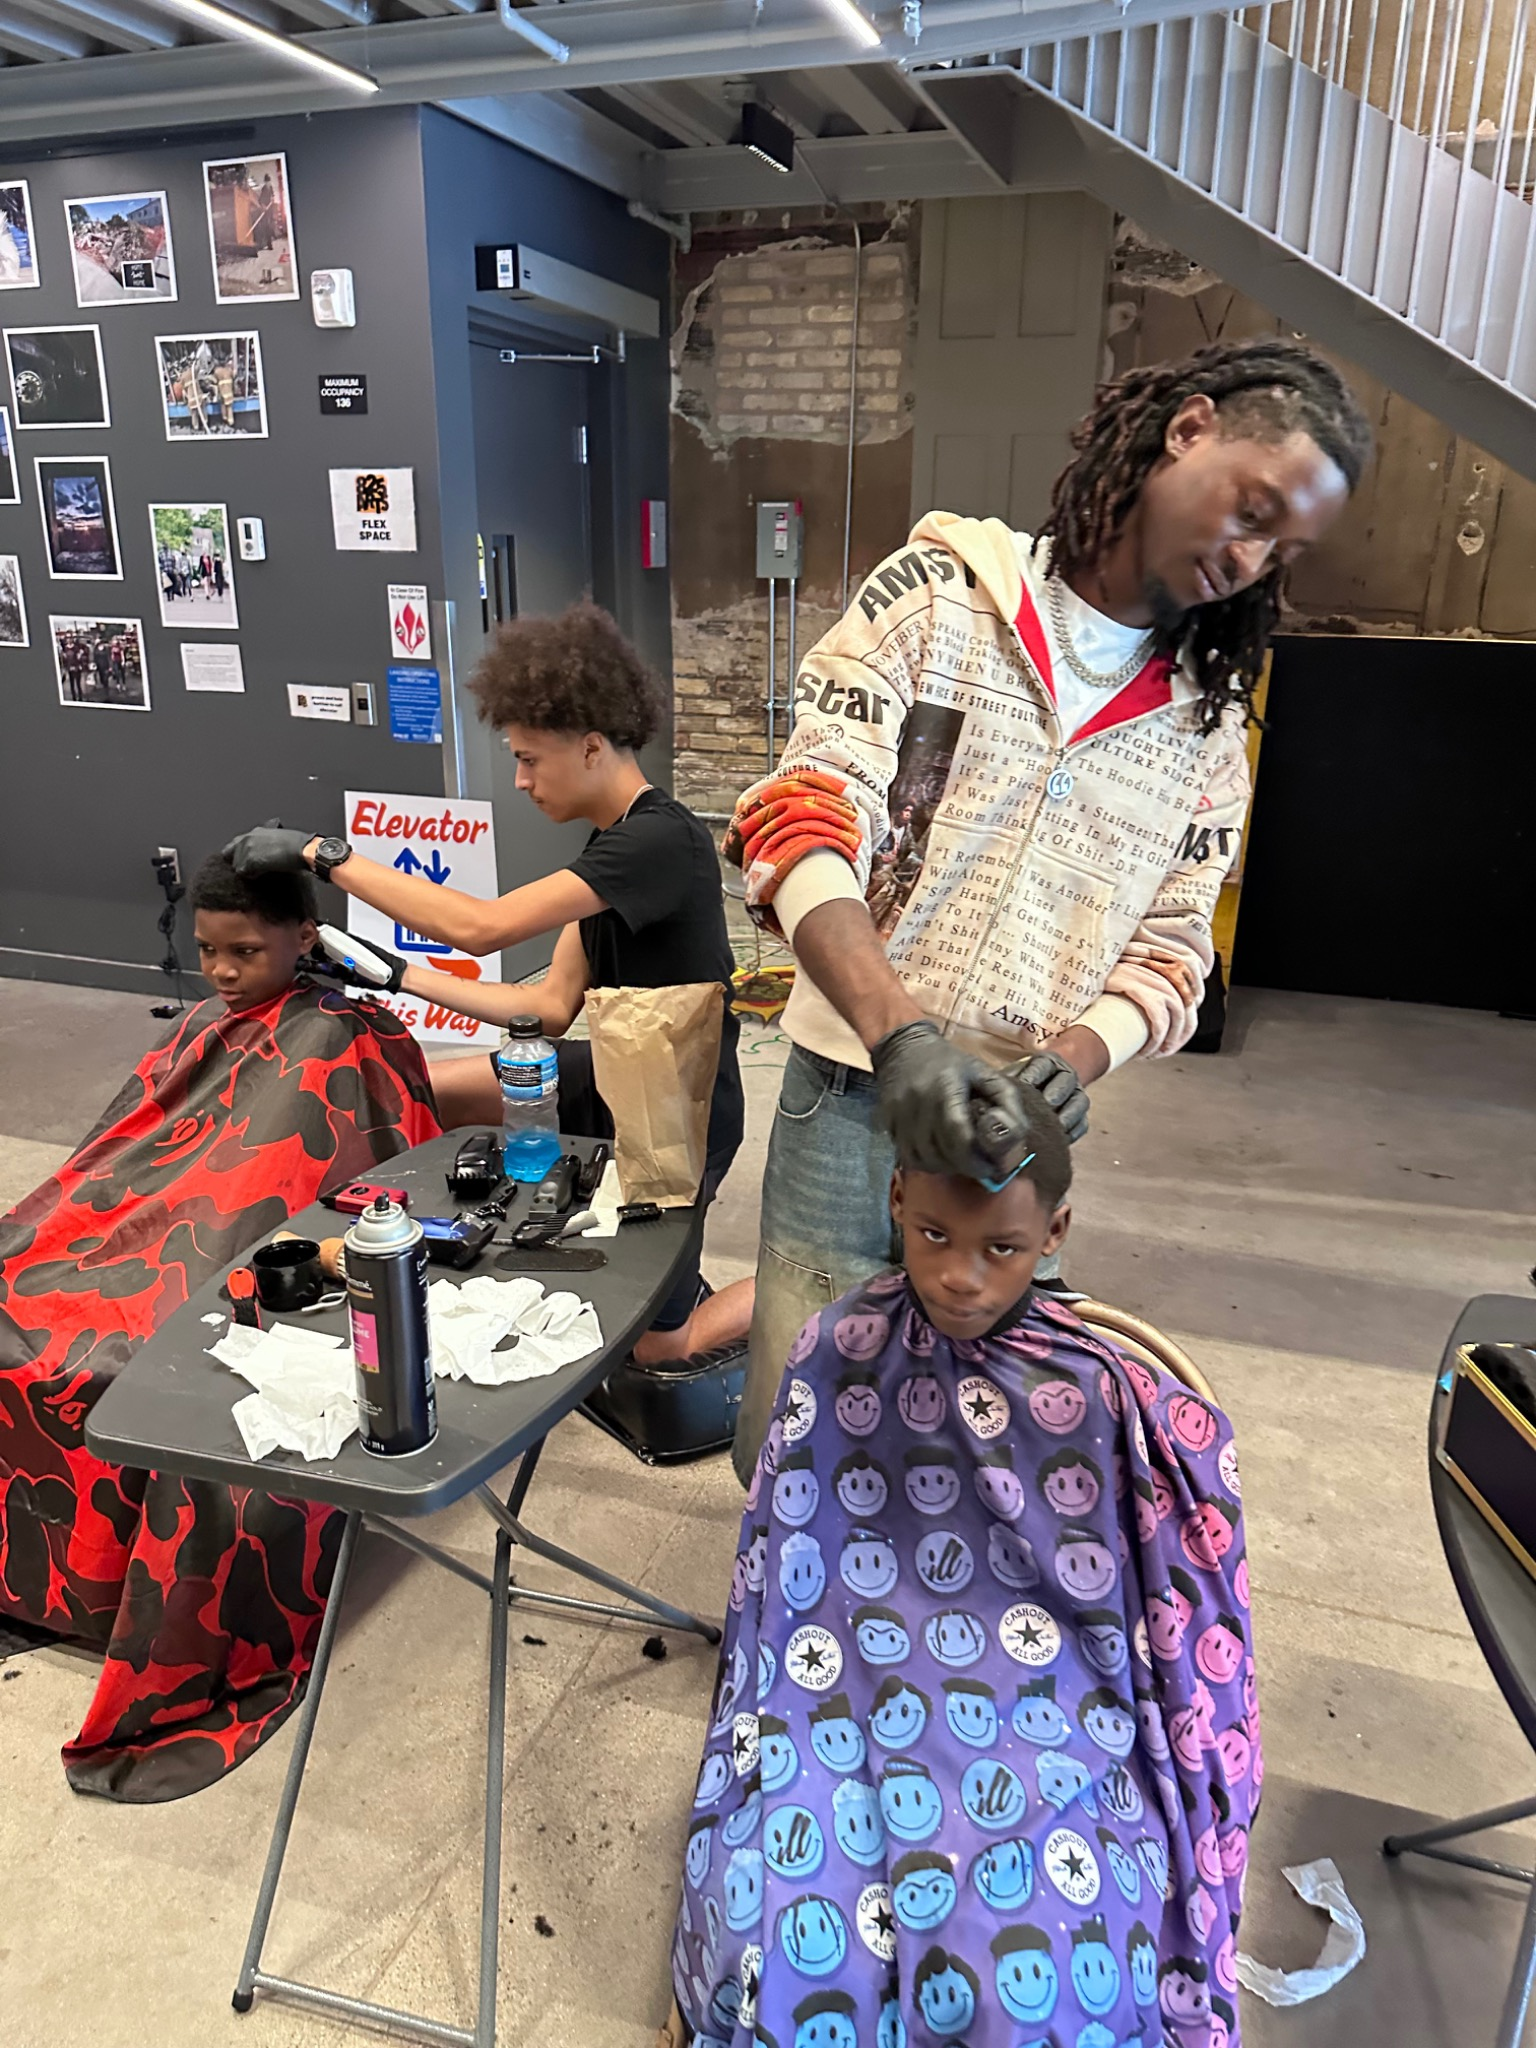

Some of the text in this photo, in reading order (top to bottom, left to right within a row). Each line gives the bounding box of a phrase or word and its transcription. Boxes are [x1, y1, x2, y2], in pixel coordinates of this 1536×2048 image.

[321, 388, 364, 397] OCCUPANCY
[325, 379, 359, 387] MAXIMUM
[362, 519, 387, 529] FLEX
[359, 531, 391, 541] SPACE
[952, 690, 966, 703] OF
[969, 695, 1007, 716] STREET
[1011, 706, 1048, 731] CULTURE
[964, 745, 996, 763] Just
[970, 724, 984, 738] Is
[1078, 757, 1103, 776] The
[1108, 769, 1154, 796] Hoodie
[351, 800, 489, 845] Elevator
[968, 786, 995, 804] Was
[1110, 833, 1128, 851] My
[945, 803, 987, 822] Room
[1052, 833, 1072, 850] Of
[1076, 842, 1105, 862] Shit
[959, 867, 1001, 887] Along
[1030, 871, 1053, 891] Was
[1055, 884, 1110, 917] Another
[945, 902, 962, 917] To
[968, 909, 982, 921] It
[1017, 908, 1038, 926] Get
[1042, 920, 1072, 943] Some
[938, 940, 970, 957] That
[991, 961, 1023, 984] Rest
[950, 924, 980, 940] Shit
[1060, 973, 1098, 999] Broke
[1064, 955, 1102, 979] After
[917, 973, 941, 988] You
[1004, 988, 1028, 1007] Hit
[424, 1003, 482, 1038] Way
[1004, 1607, 1051, 1627] CASHOUT
[789, 1629, 831, 1652] CASHOUT
[1011, 1645, 1055, 1662] ALL GOOD
[797, 1665, 837, 1686] ALL GOOD
